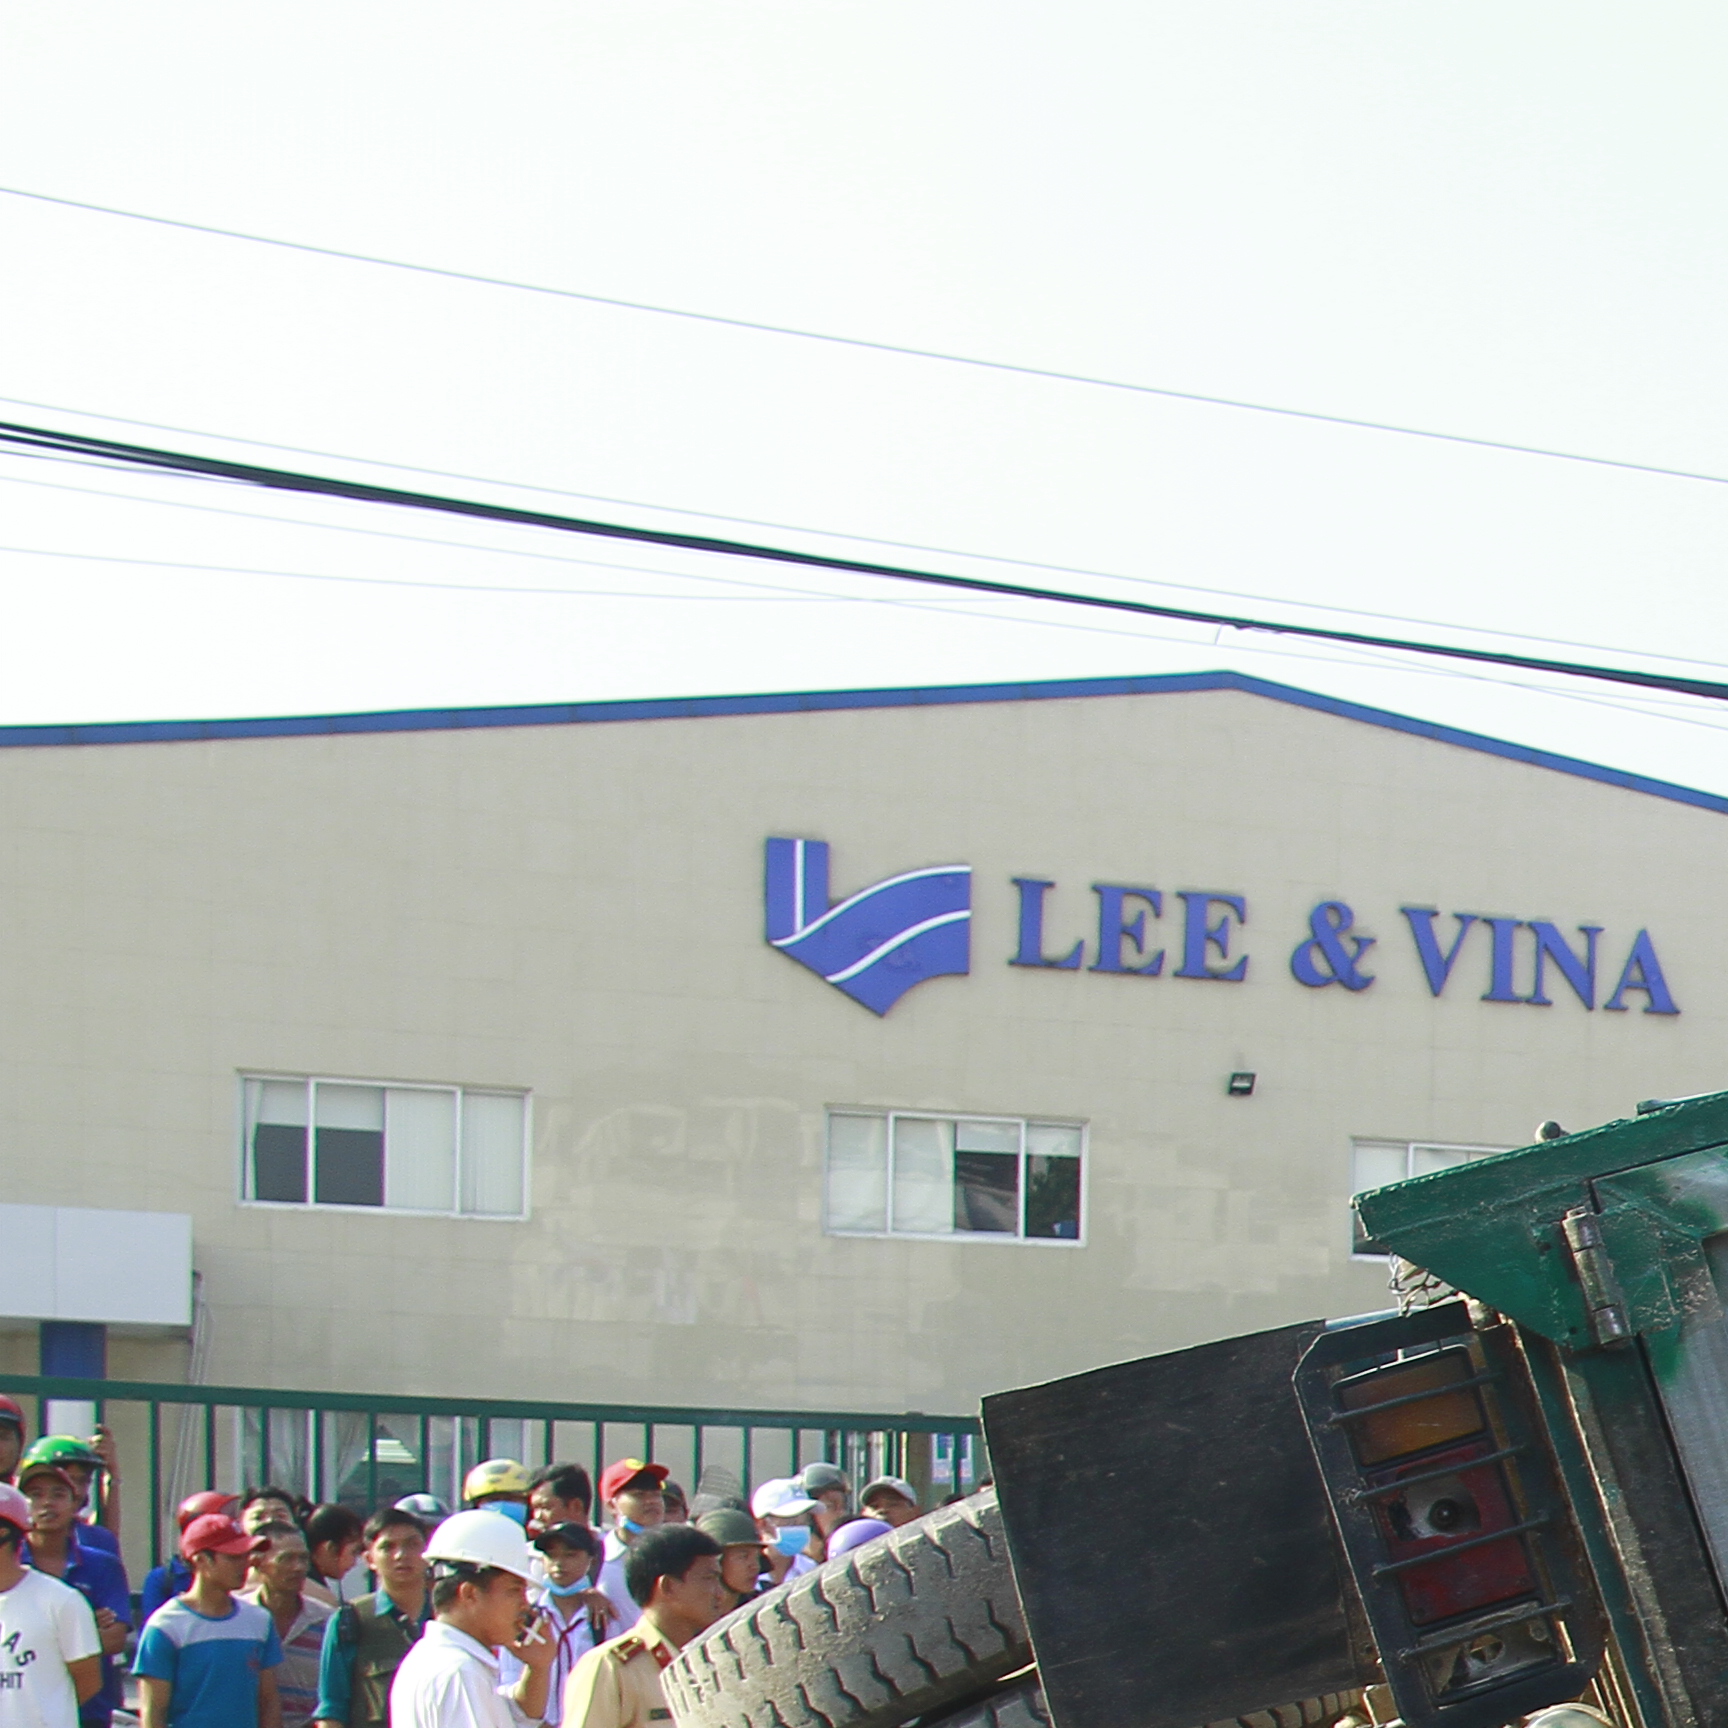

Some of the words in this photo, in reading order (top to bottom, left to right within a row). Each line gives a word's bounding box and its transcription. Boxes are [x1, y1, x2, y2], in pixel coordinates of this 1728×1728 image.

[1007, 876, 1251, 984] LEE
[1288, 899, 1378, 993] &
[1400, 906, 1682, 1016] VINA
[0, 1622, 37, 1667] AS
